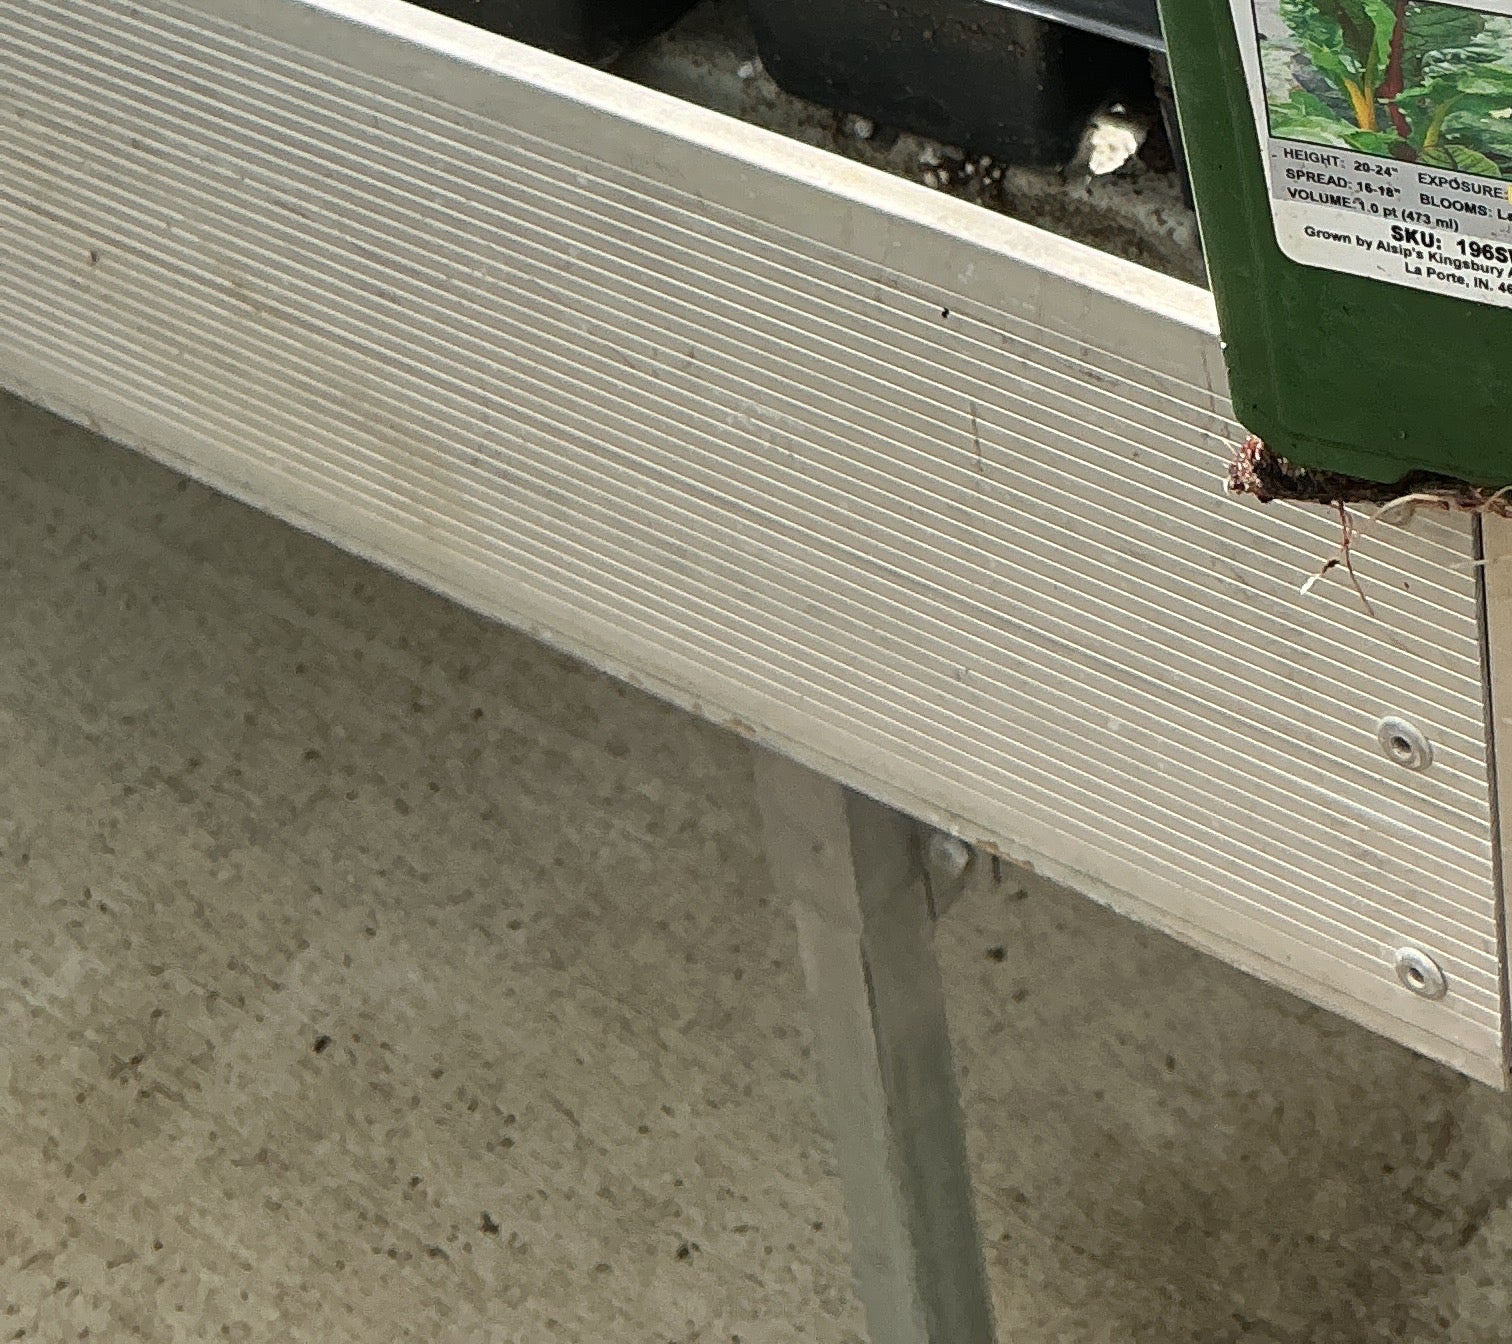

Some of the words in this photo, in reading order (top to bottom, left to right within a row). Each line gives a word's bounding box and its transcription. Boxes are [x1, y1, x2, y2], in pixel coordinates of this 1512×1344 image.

[1283, 147, 1346, 169] HEIGHT:
[1353, 160, 1399, 178] 20-24"
[1285, 167, 1353, 190] SPREAD:
[1356, 181, 1401, 199] 16-18"
[1417, 172, 1509, 201] EXPOSURE:
[1358, 198, 1379, 214] 1.0
[1382, 205, 1399, 219] pt
[1401, 208, 1432, 226] (473
[1435, 217, 1460, 233] ml)
[1419, 193, 1493, 218] BLOOMS:
[1304, 224, 1352, 245] Grown
[1356, 234, 1373, 251] by
[1376, 239, 1424, 260] Alsip's
[1428, 250, 1503, 279] Kingsbury
[1390, 223, 1442, 251] SKU:
[1404, 261, 1423, 276] La
[1426, 266, 1470, 289] Porte,
